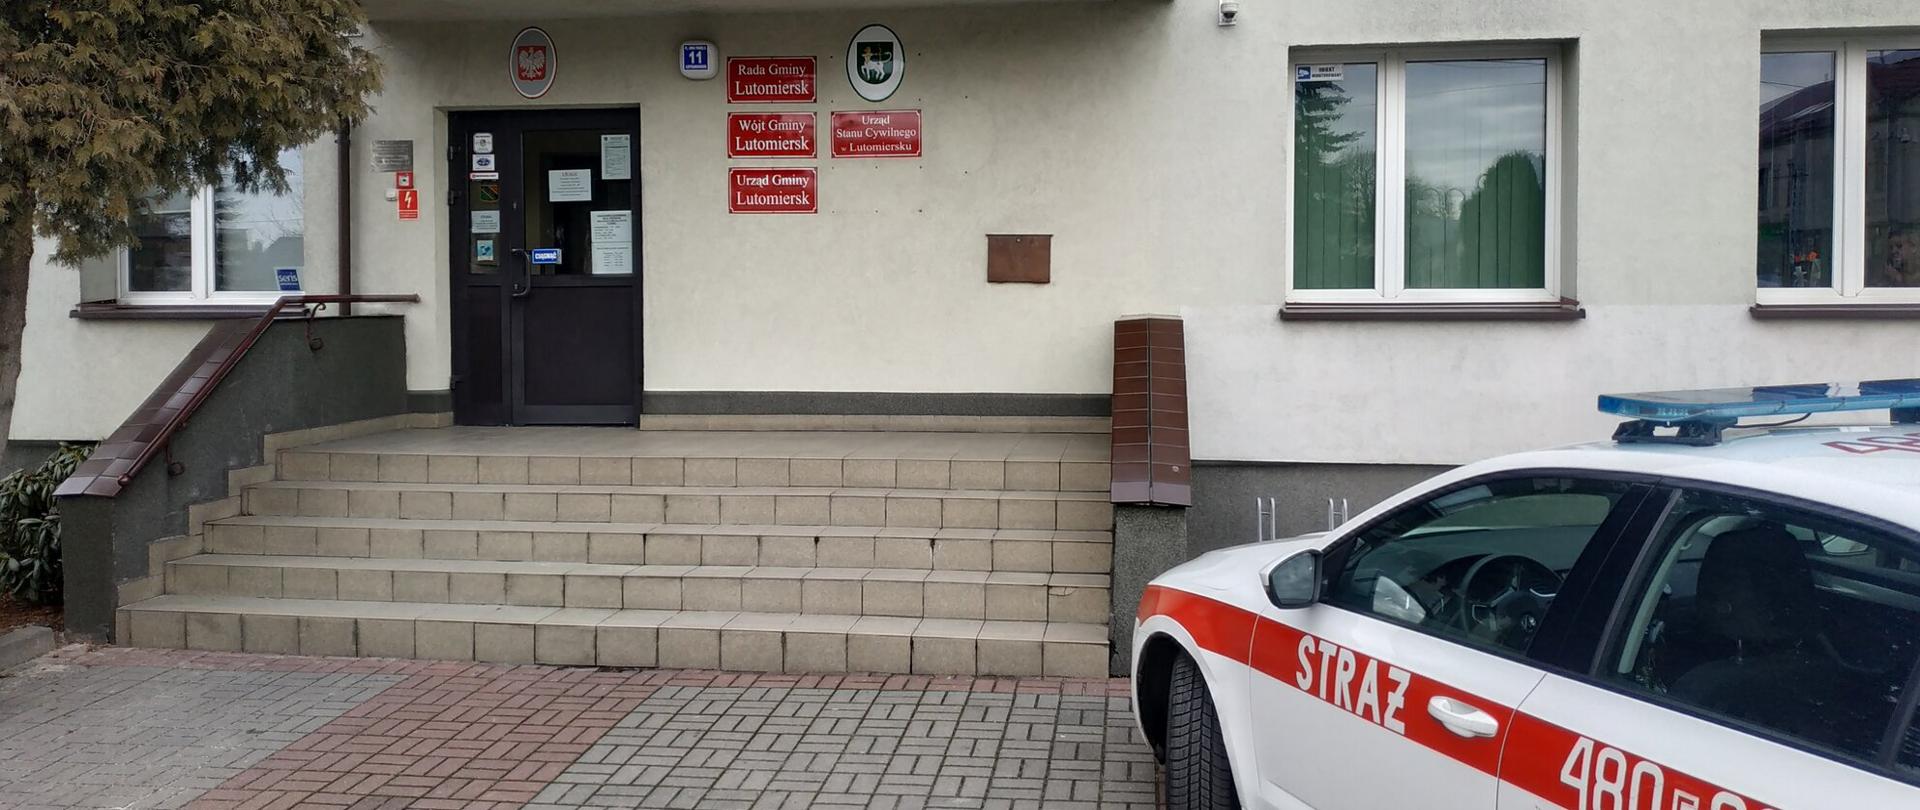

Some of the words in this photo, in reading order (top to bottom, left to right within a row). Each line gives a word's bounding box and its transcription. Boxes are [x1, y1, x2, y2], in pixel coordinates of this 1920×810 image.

[689, 50, 702, 64] 11
[738, 64, 766, 76] Rada
[768, 63, 807, 78] Gminy
[735, 81, 809, 96] Lutomiersk
[738, 119, 766, 133] Wójt
[768, 119, 806, 133] Gminy
[861, 115, 890, 126] Urząd
[836, 128, 863, 138] Stanu
[865, 127, 917, 140] Cywilnego
[735, 136, 809, 151] Lutomiersk
[849, 141, 912, 152] Lutomiersku
[736, 174, 769, 188] Urząd
[772, 174, 810, 188] Gminy
[736, 191, 810, 205] Lutomiersk
[1296, 635, 1411, 735] STRAŻ
